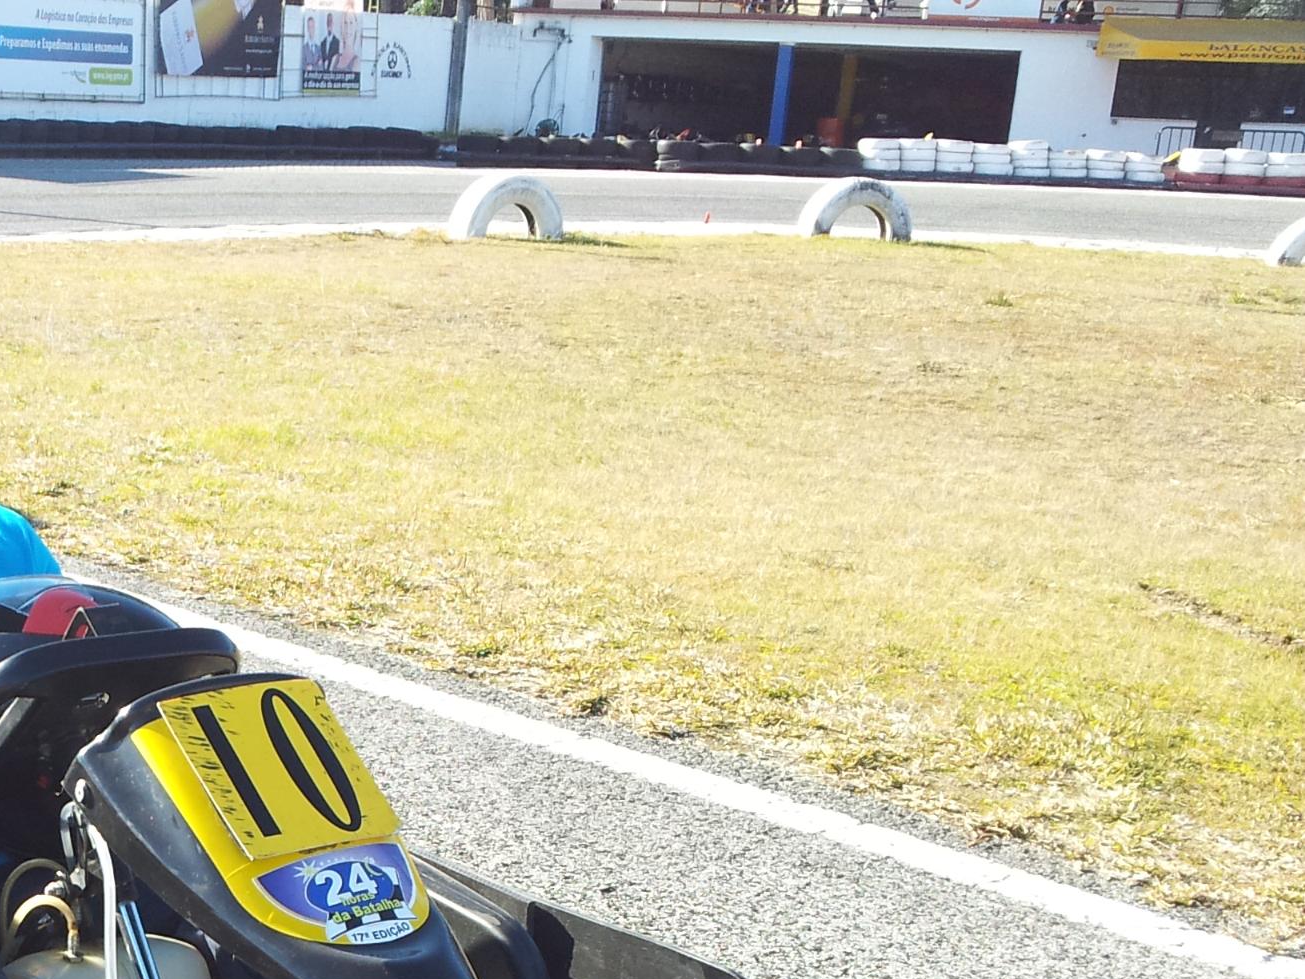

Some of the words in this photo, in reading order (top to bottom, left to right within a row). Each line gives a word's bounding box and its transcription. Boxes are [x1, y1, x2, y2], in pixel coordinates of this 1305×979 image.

[0, 35, 36, 50] Preparamos
[42, 37, 73, 52] Expedimos
[191, 688, 362, 839] 10
[315, 862, 378, 906] 24
[339, 893, 376, 906] horas
[331, 911, 351, 925] da
[353, 899, 403, 918] Batalha
[373, 922, 411, 941] EDIÇÃO
